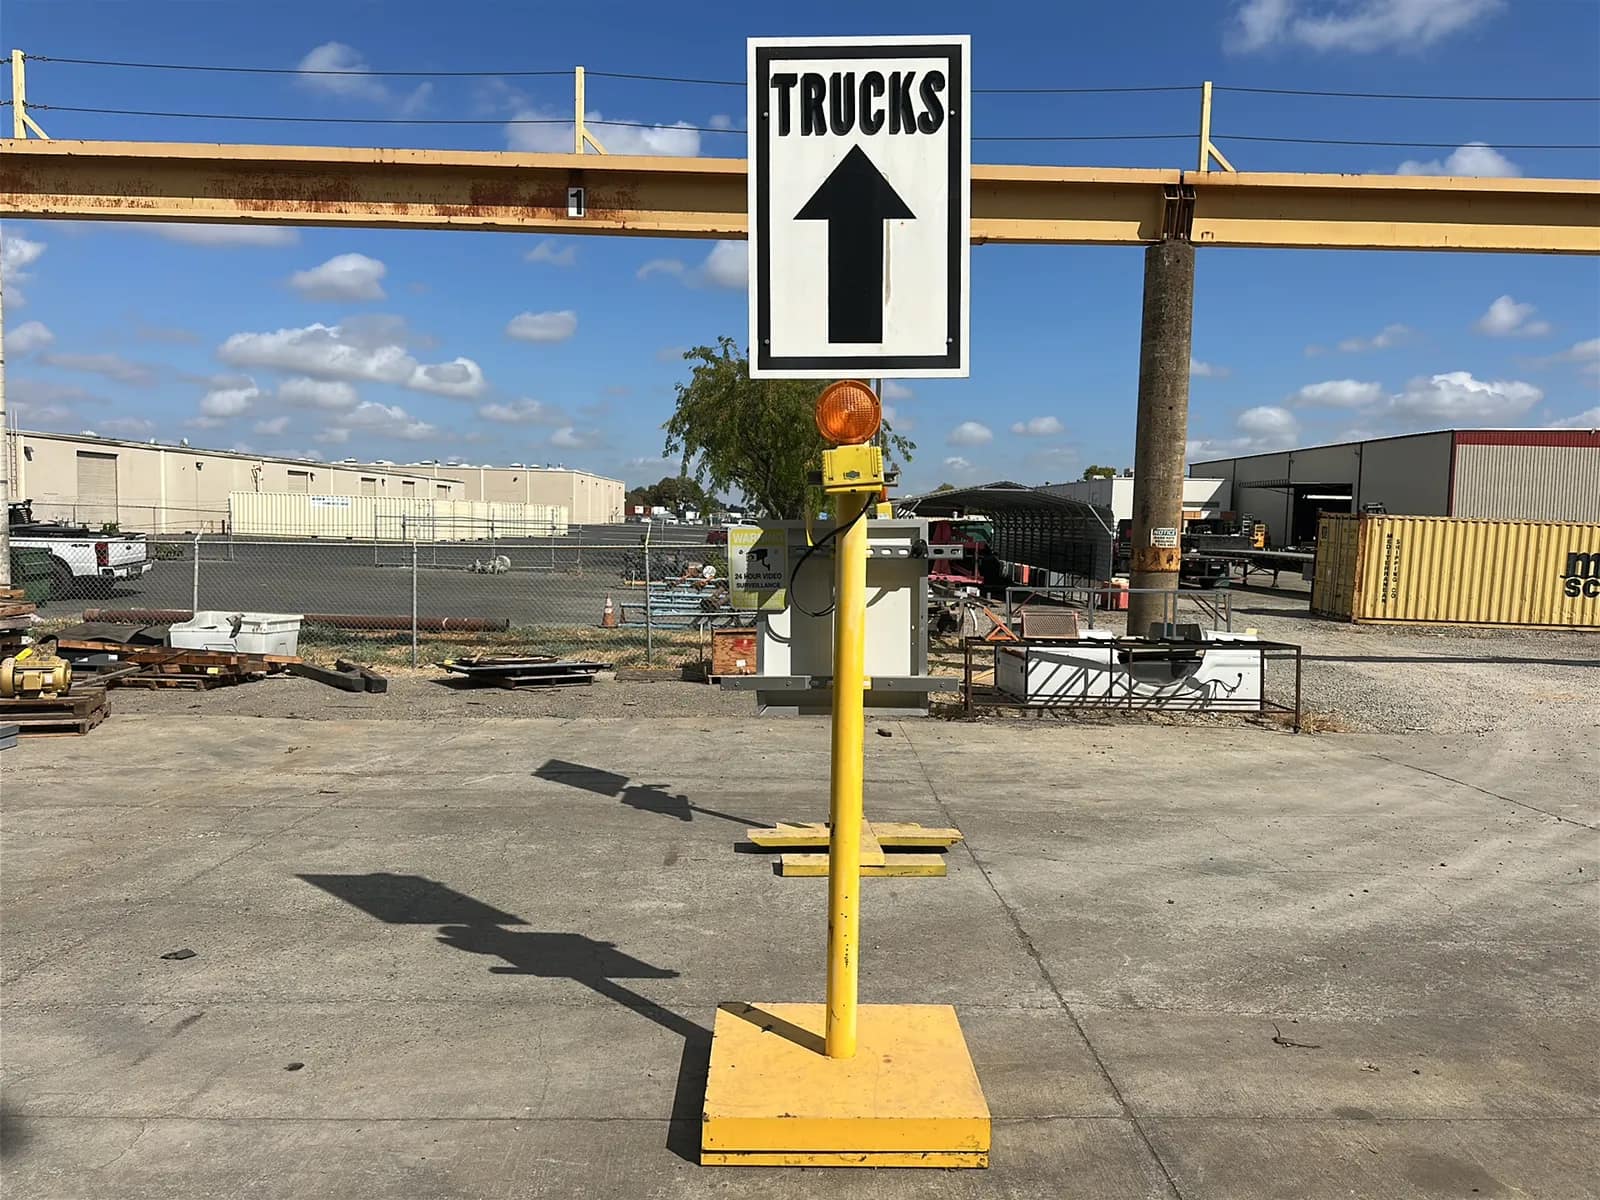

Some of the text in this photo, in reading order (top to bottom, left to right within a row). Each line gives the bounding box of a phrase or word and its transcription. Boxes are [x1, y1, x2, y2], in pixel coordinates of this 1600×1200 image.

[770, 70, 946, 136] TRUCKS
[570, 189, 582, 215] 1
[734, 572, 783, 580] 24 HOUR VIDEO
